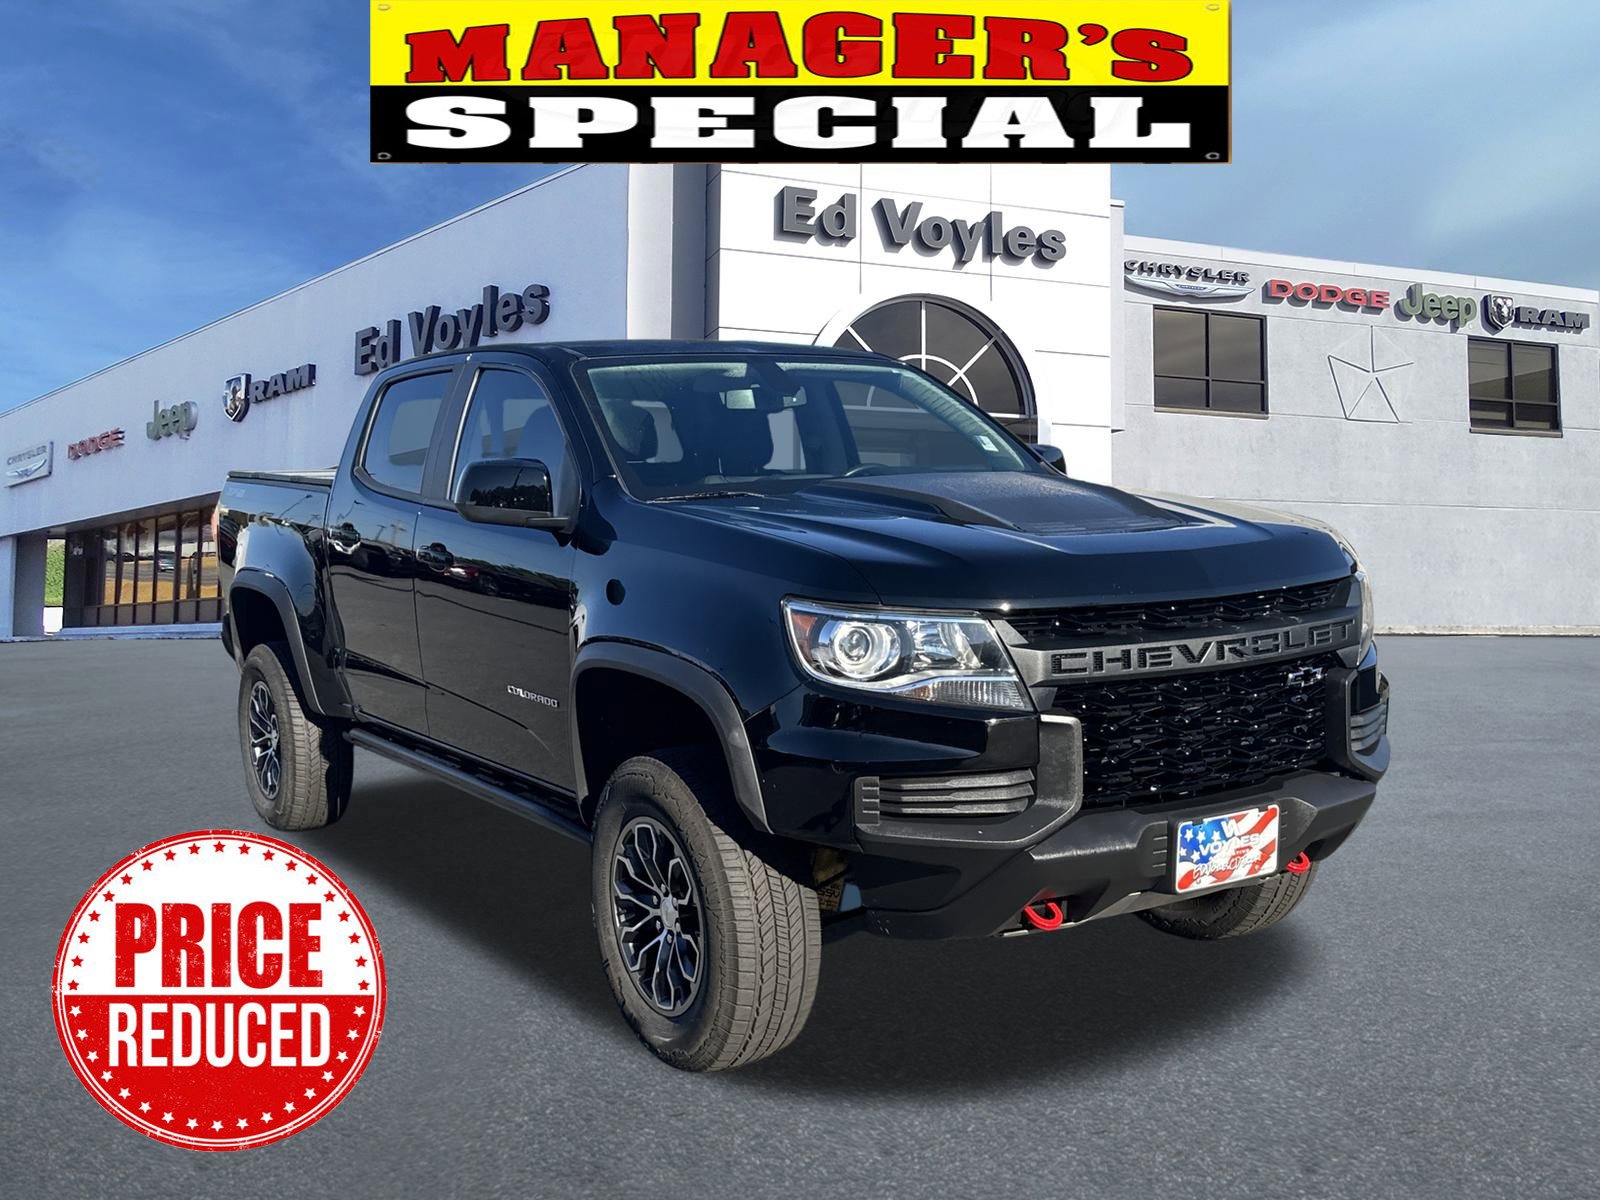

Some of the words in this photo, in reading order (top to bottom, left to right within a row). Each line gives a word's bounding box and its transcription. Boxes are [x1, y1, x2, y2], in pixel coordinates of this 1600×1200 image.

[774, 185, 857, 247] Ed
[871, 197, 1068, 270] Voyles
[1124, 259, 1251, 286] CHRYSLER
[1263, 279, 1391, 314] DODGE
[1396, 282, 1478, 331] Jeep
[354, 319, 401, 376] Ed
[408, 284, 551, 357] Voyles
[1513, 306, 1591, 333] RAM
[249, 363, 316, 404] RAM
[146, 400, 199, 440] Jeep
[68, 427, 125, 460] DODGE
[1050, 620, 1356, 677] CHEVROLET
[507, 685, 558, 708] COLORADO
